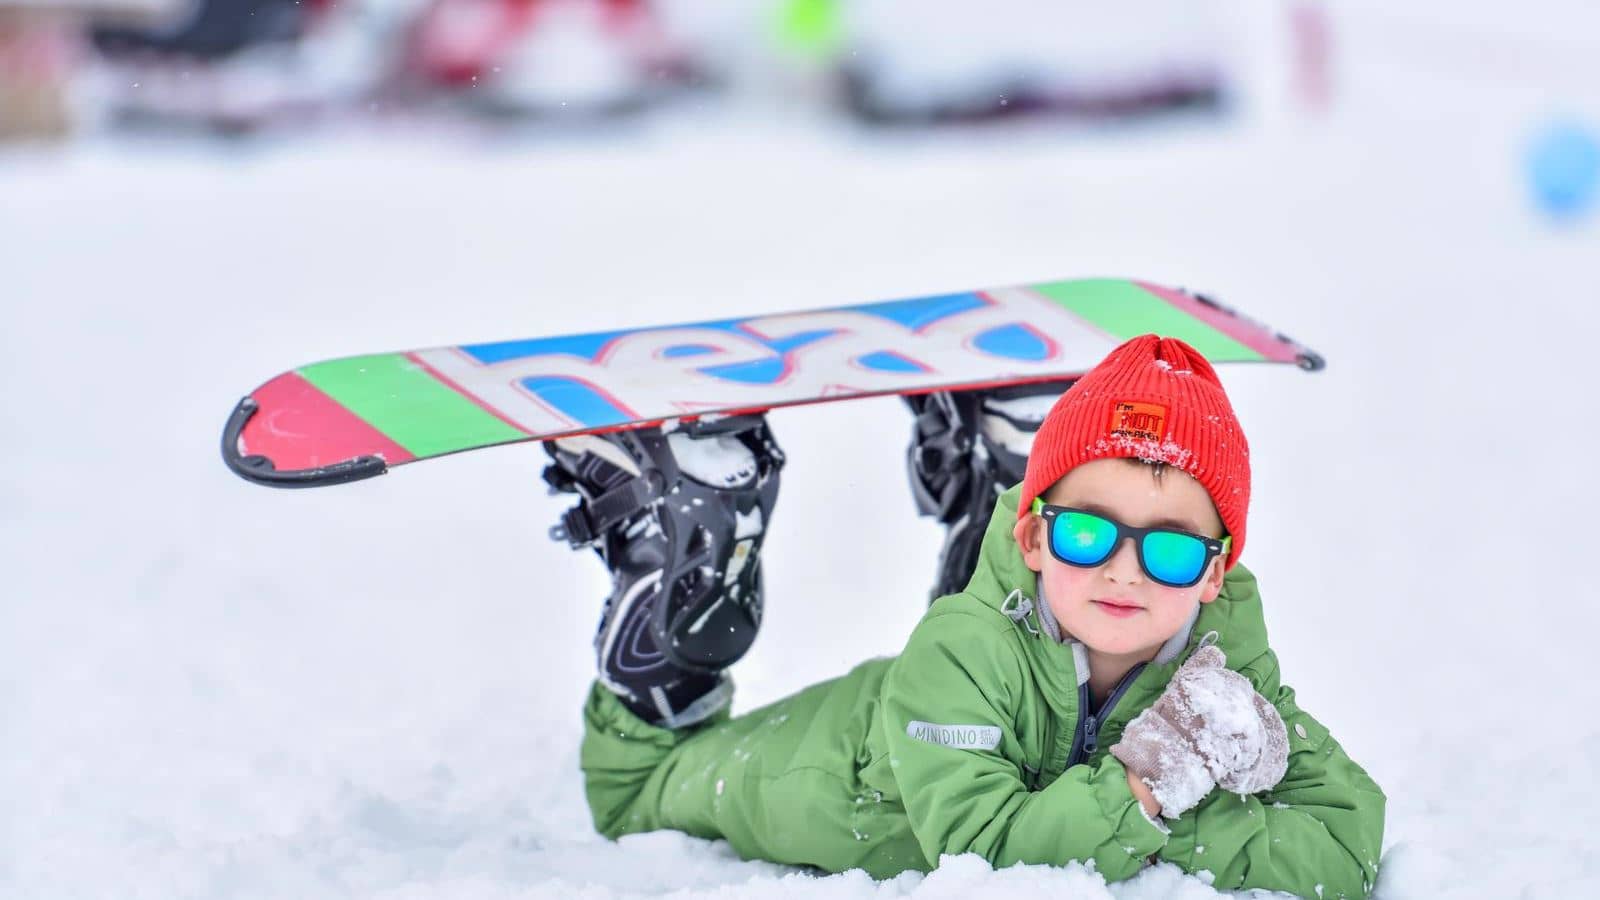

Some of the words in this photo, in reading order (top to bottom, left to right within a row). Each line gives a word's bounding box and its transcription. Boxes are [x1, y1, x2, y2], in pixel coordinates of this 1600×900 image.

[404, 285, 1122, 436] head
[1120, 412, 1163, 432] NOT
[914, 727, 977, 745] MINIDINO
